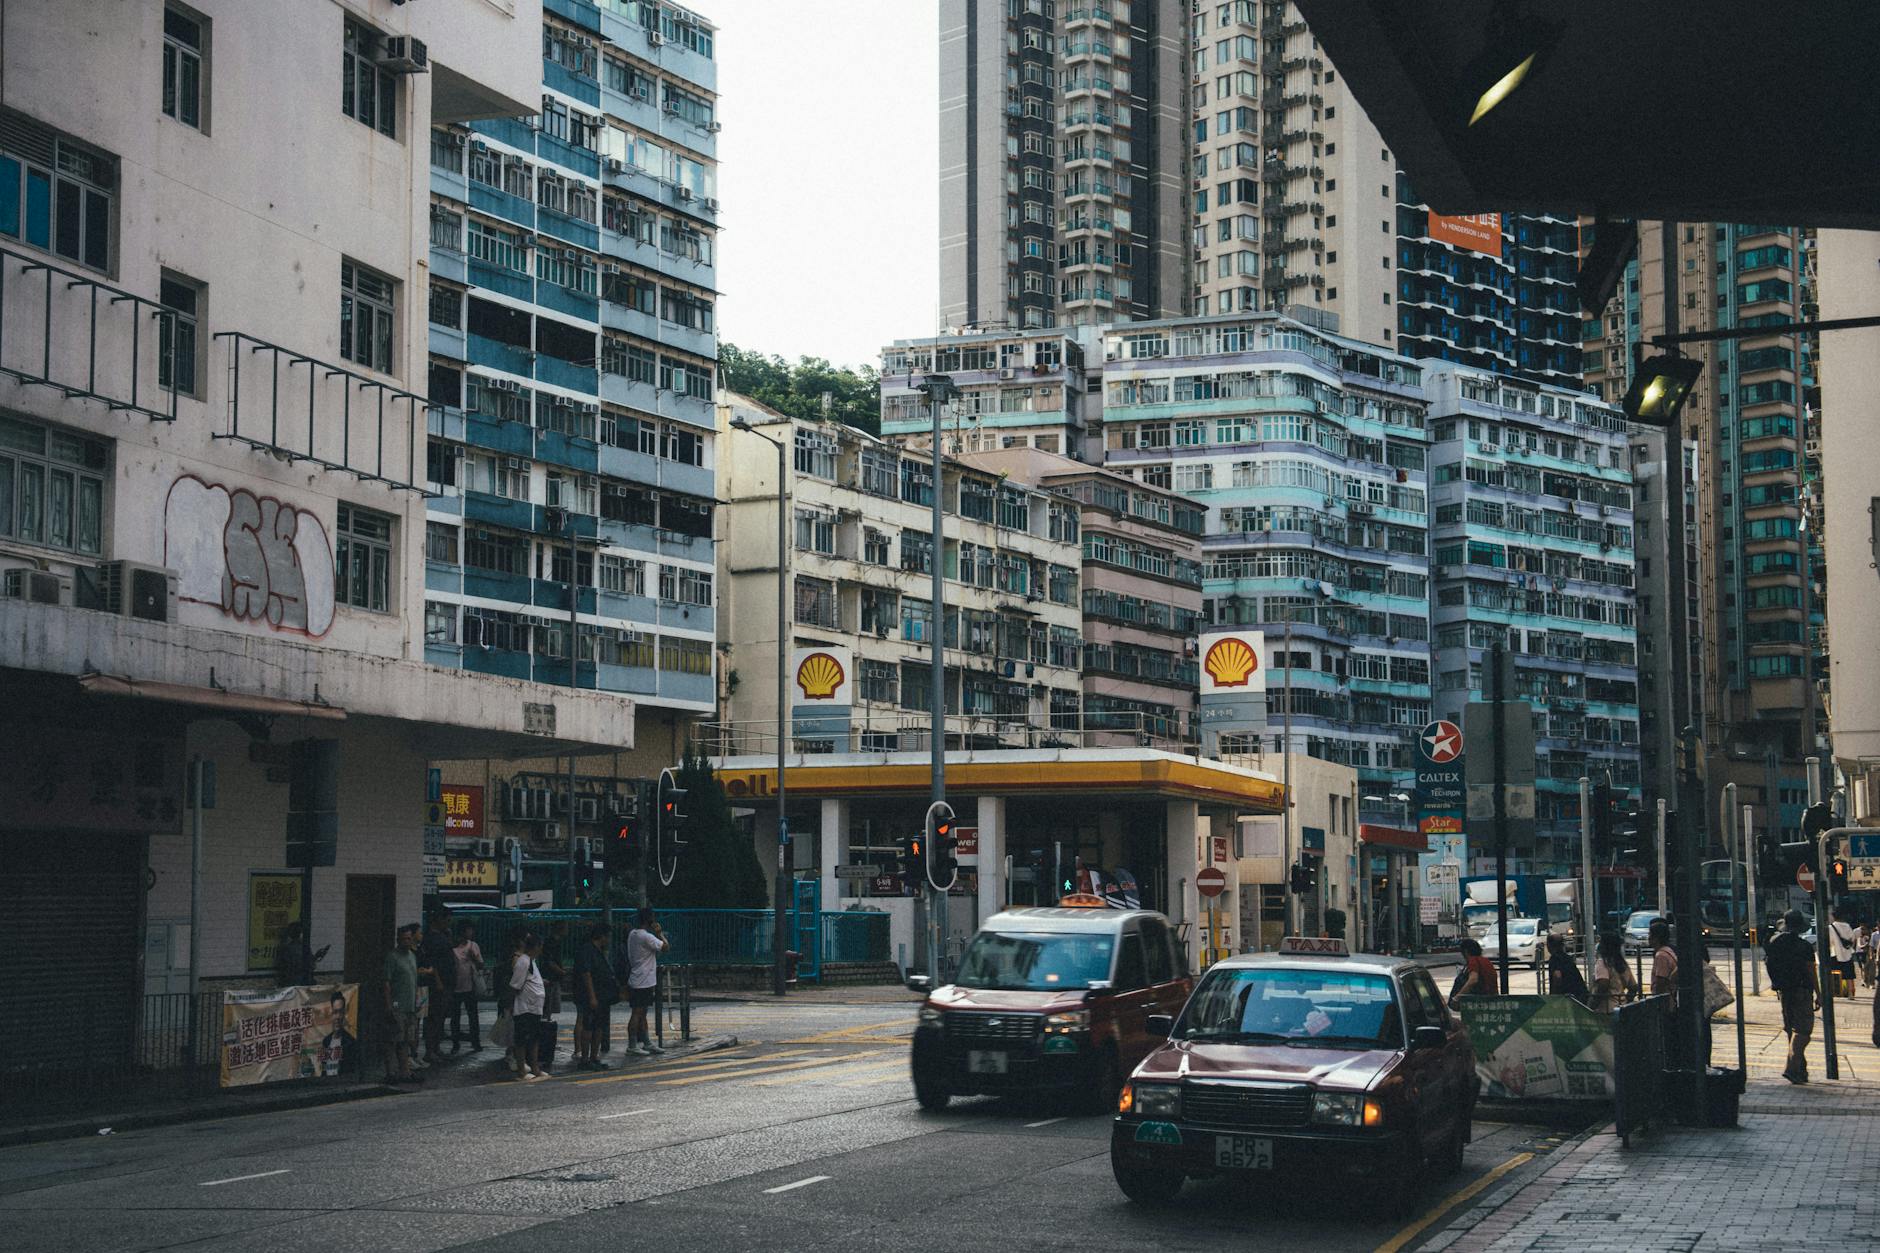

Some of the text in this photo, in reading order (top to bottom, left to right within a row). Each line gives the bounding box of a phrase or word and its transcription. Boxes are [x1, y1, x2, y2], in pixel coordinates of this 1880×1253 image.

[1441, 220, 1491, 240] by HENDERSON LAND
[1205, 710, 1216, 718] 24
[1419, 773, 1460, 783] CALTEX
[1431, 789, 1461, 797] TECHRON
[441, 792, 471, 815] 惠康
[1430, 815, 1451, 828] Star
[1287, 938, 1340, 952] TAXI
[241, 1007, 313, 1039] 活化排檔政策
[1233, 1138, 1256, 1152] PR
[1220, 1151, 1268, 1168] 8672
